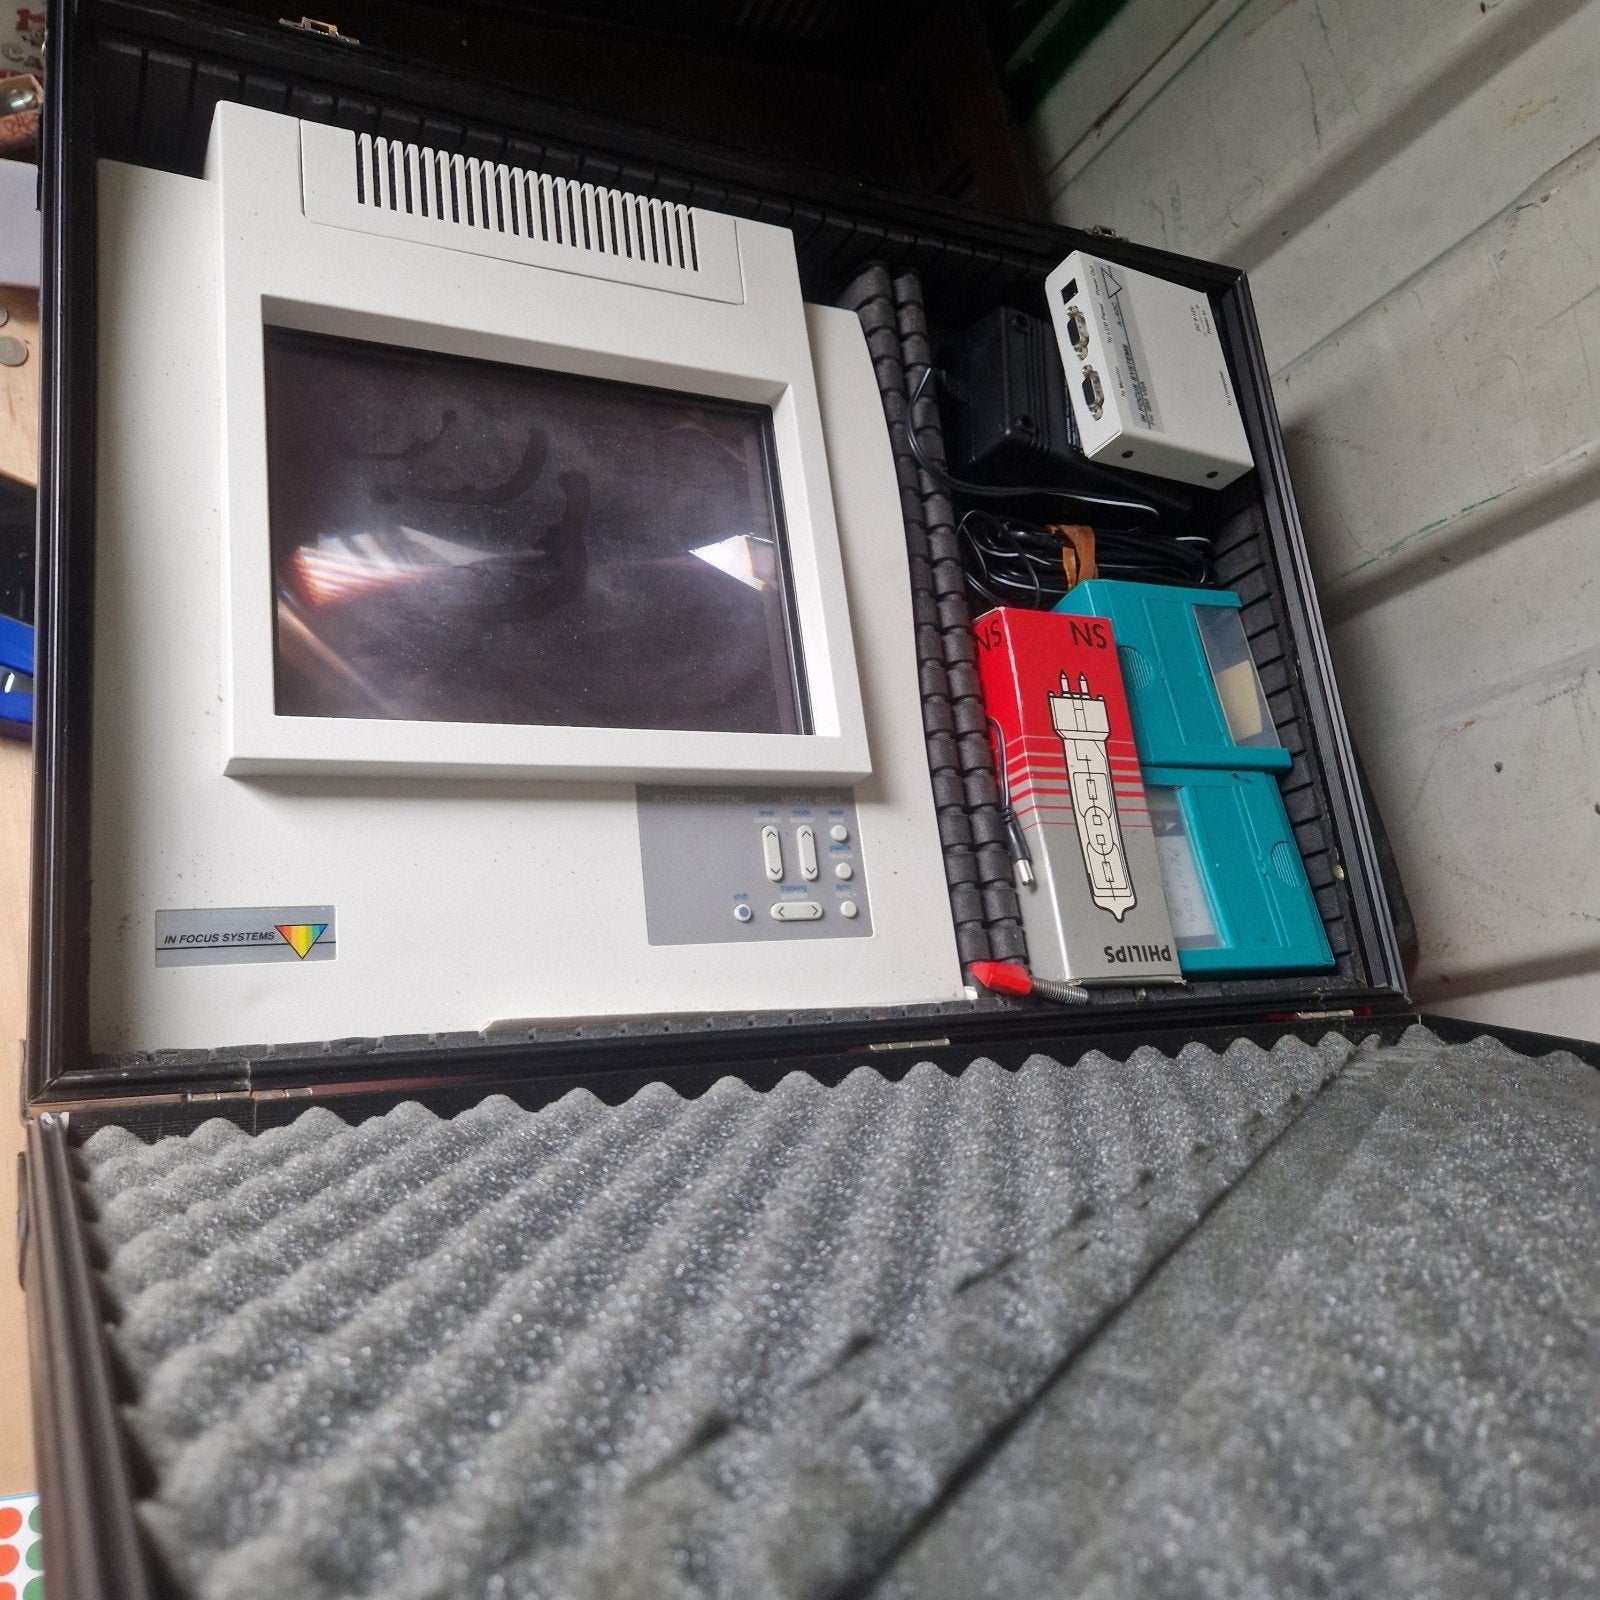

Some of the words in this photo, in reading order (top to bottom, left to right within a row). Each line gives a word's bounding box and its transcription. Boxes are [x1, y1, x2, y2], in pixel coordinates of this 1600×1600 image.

[1102, 321, 1111, 335] LCD
[1122, 343, 1137, 381] SYSTEMS
[1115, 366, 1124, 389] Monitor
[1219, 370, 1230, 398] Computer
[1132, 383, 1145, 413] FOCUS
[781, 892, 808, 900] position
[164, 935, 177, 945] IN
[179, 932, 220, 944] FOCUS
[222, 931, 275, 943] SYSTEMS
[1103, 944, 1172, 963] PHILIPS
